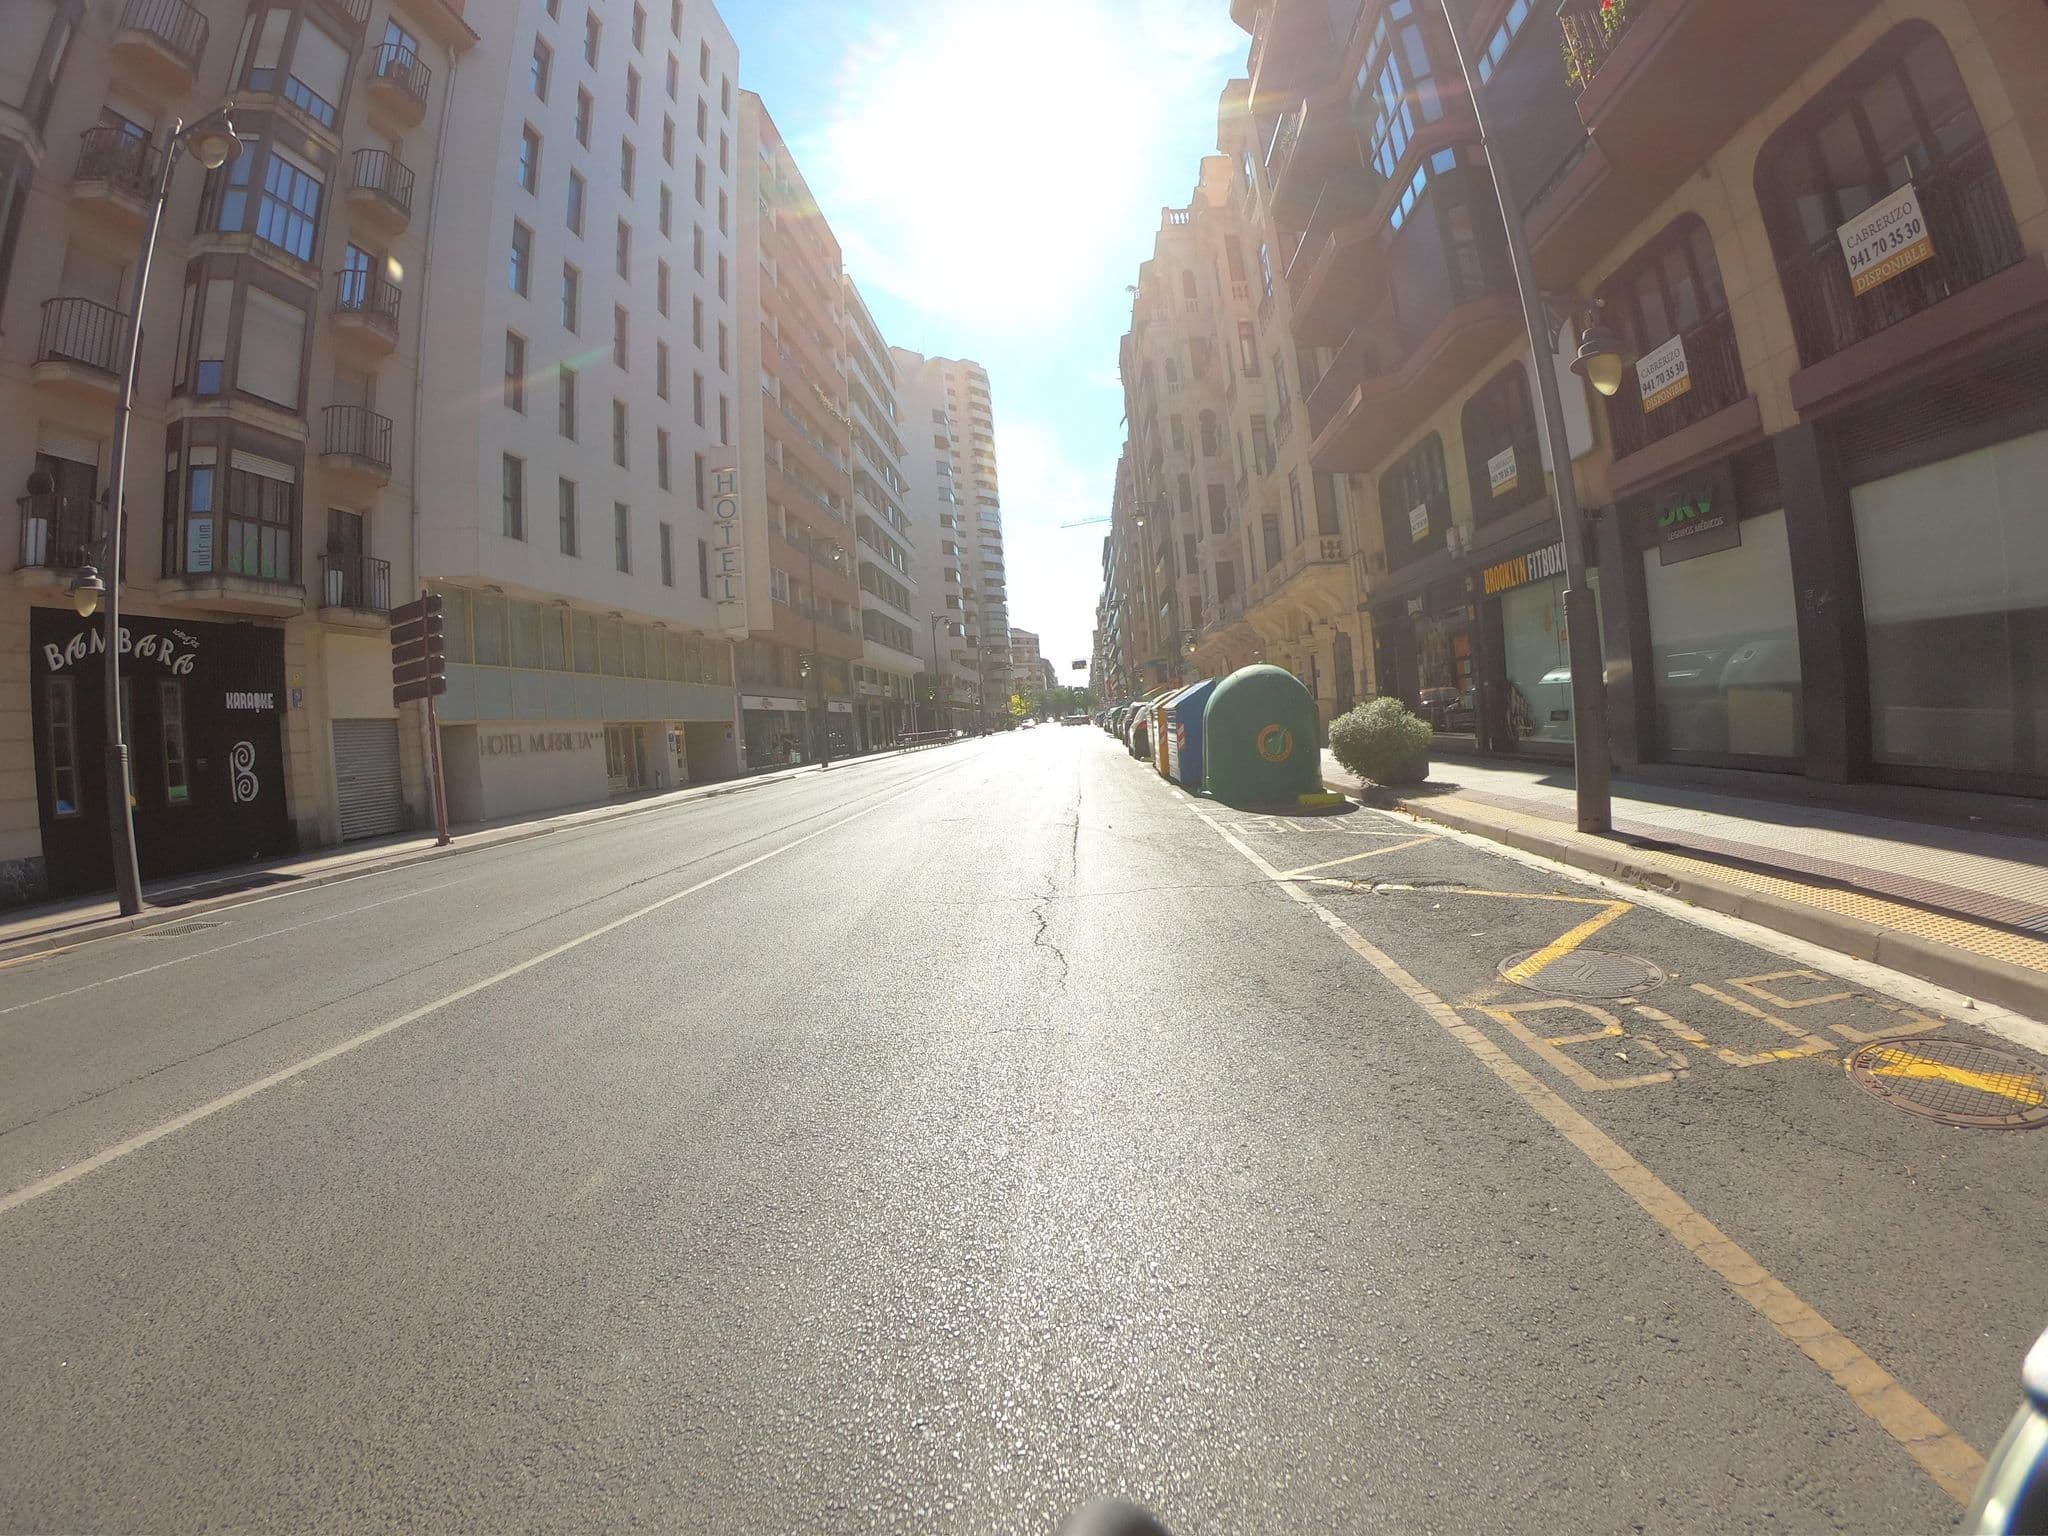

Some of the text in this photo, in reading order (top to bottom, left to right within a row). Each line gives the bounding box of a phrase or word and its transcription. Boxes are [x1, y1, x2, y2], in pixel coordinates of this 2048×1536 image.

[1846, 202, 1912, 249] CABRERIZO
[1850, 218, 1920, 271] 941 70 35 30
[1856, 243, 1928, 291] DISPONIBLE
[1640, 348, 1681, 378] CABRERIZO
[1642, 379, 1655, 395] 941
[1655, 373, 1665, 386] 70
[1675, 361, 1685, 375] 30
[717, 473, 736, 599] HOTEL
[1484, 541, 1567, 594] BROOKLYN FITBOXI
[225, 692, 274, 713] KARAOKE
[480, 733, 524, 756] HOTEL
[1478, 969, 1947, 1092] BUS
